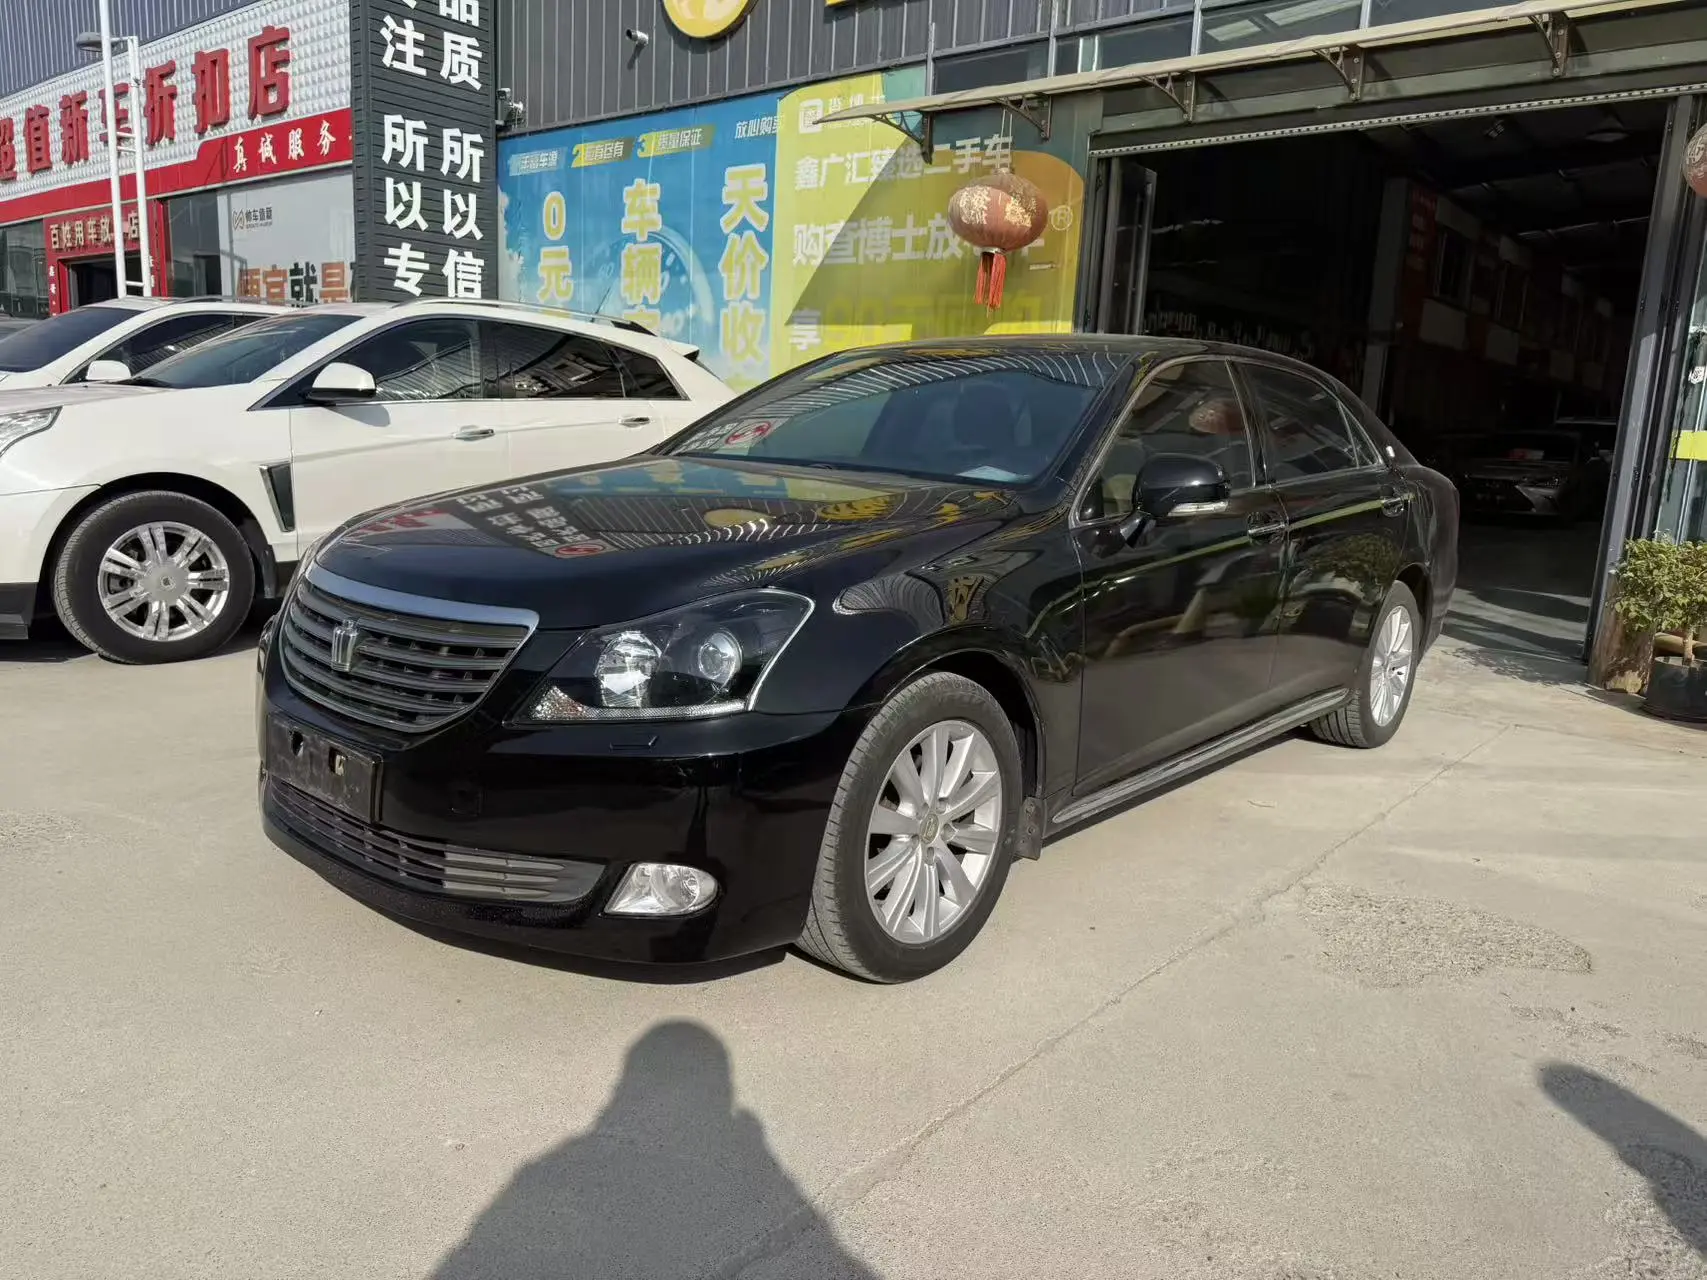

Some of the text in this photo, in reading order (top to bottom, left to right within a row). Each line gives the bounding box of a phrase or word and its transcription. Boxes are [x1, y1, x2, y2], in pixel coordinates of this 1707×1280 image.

[380, 0, 427, 77] 注
[537, 191, 574, 317] 0元
[718, 163, 770, 389] 天价收
[793, 212, 1045, 265] 购查博士放
